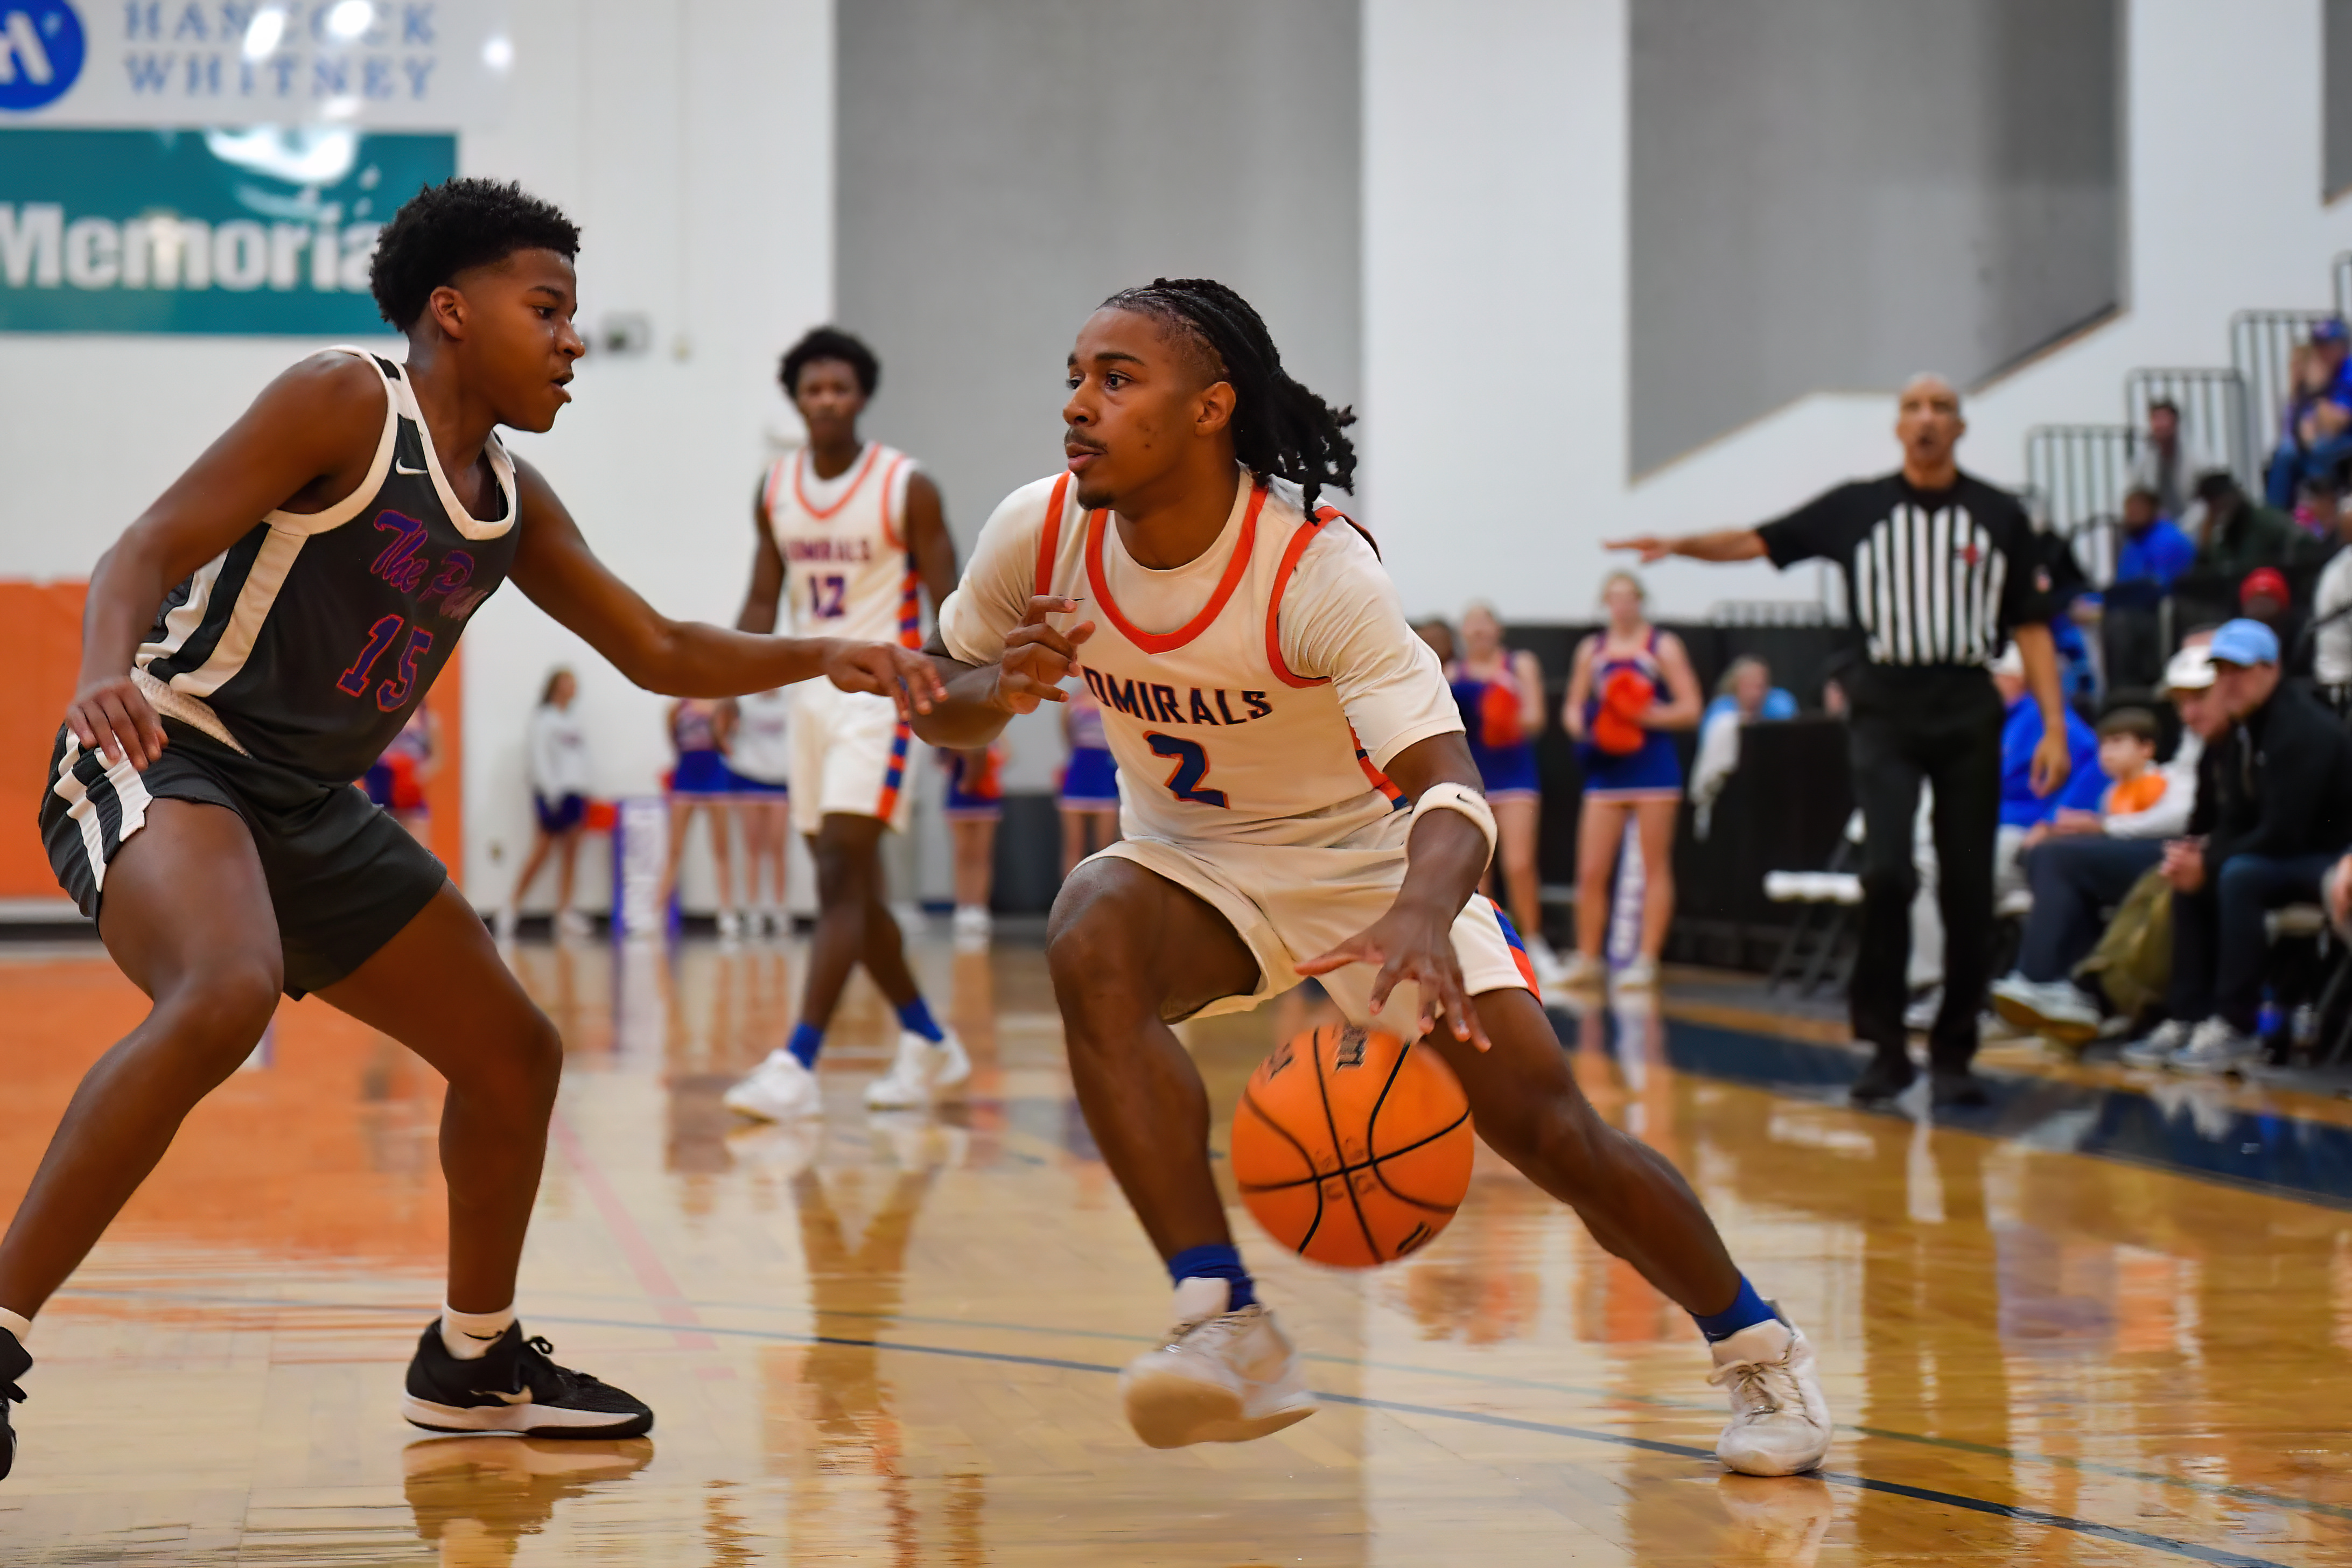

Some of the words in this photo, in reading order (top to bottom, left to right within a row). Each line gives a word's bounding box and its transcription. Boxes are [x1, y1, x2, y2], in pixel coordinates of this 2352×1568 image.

[123, 53, 436, 100] WHITNEY
[370, 509, 429, 593] The
[336, 613, 433, 712] 15
[1080, 664, 1273, 726] DMIRALS
[1142, 730, 1230, 809] 2
